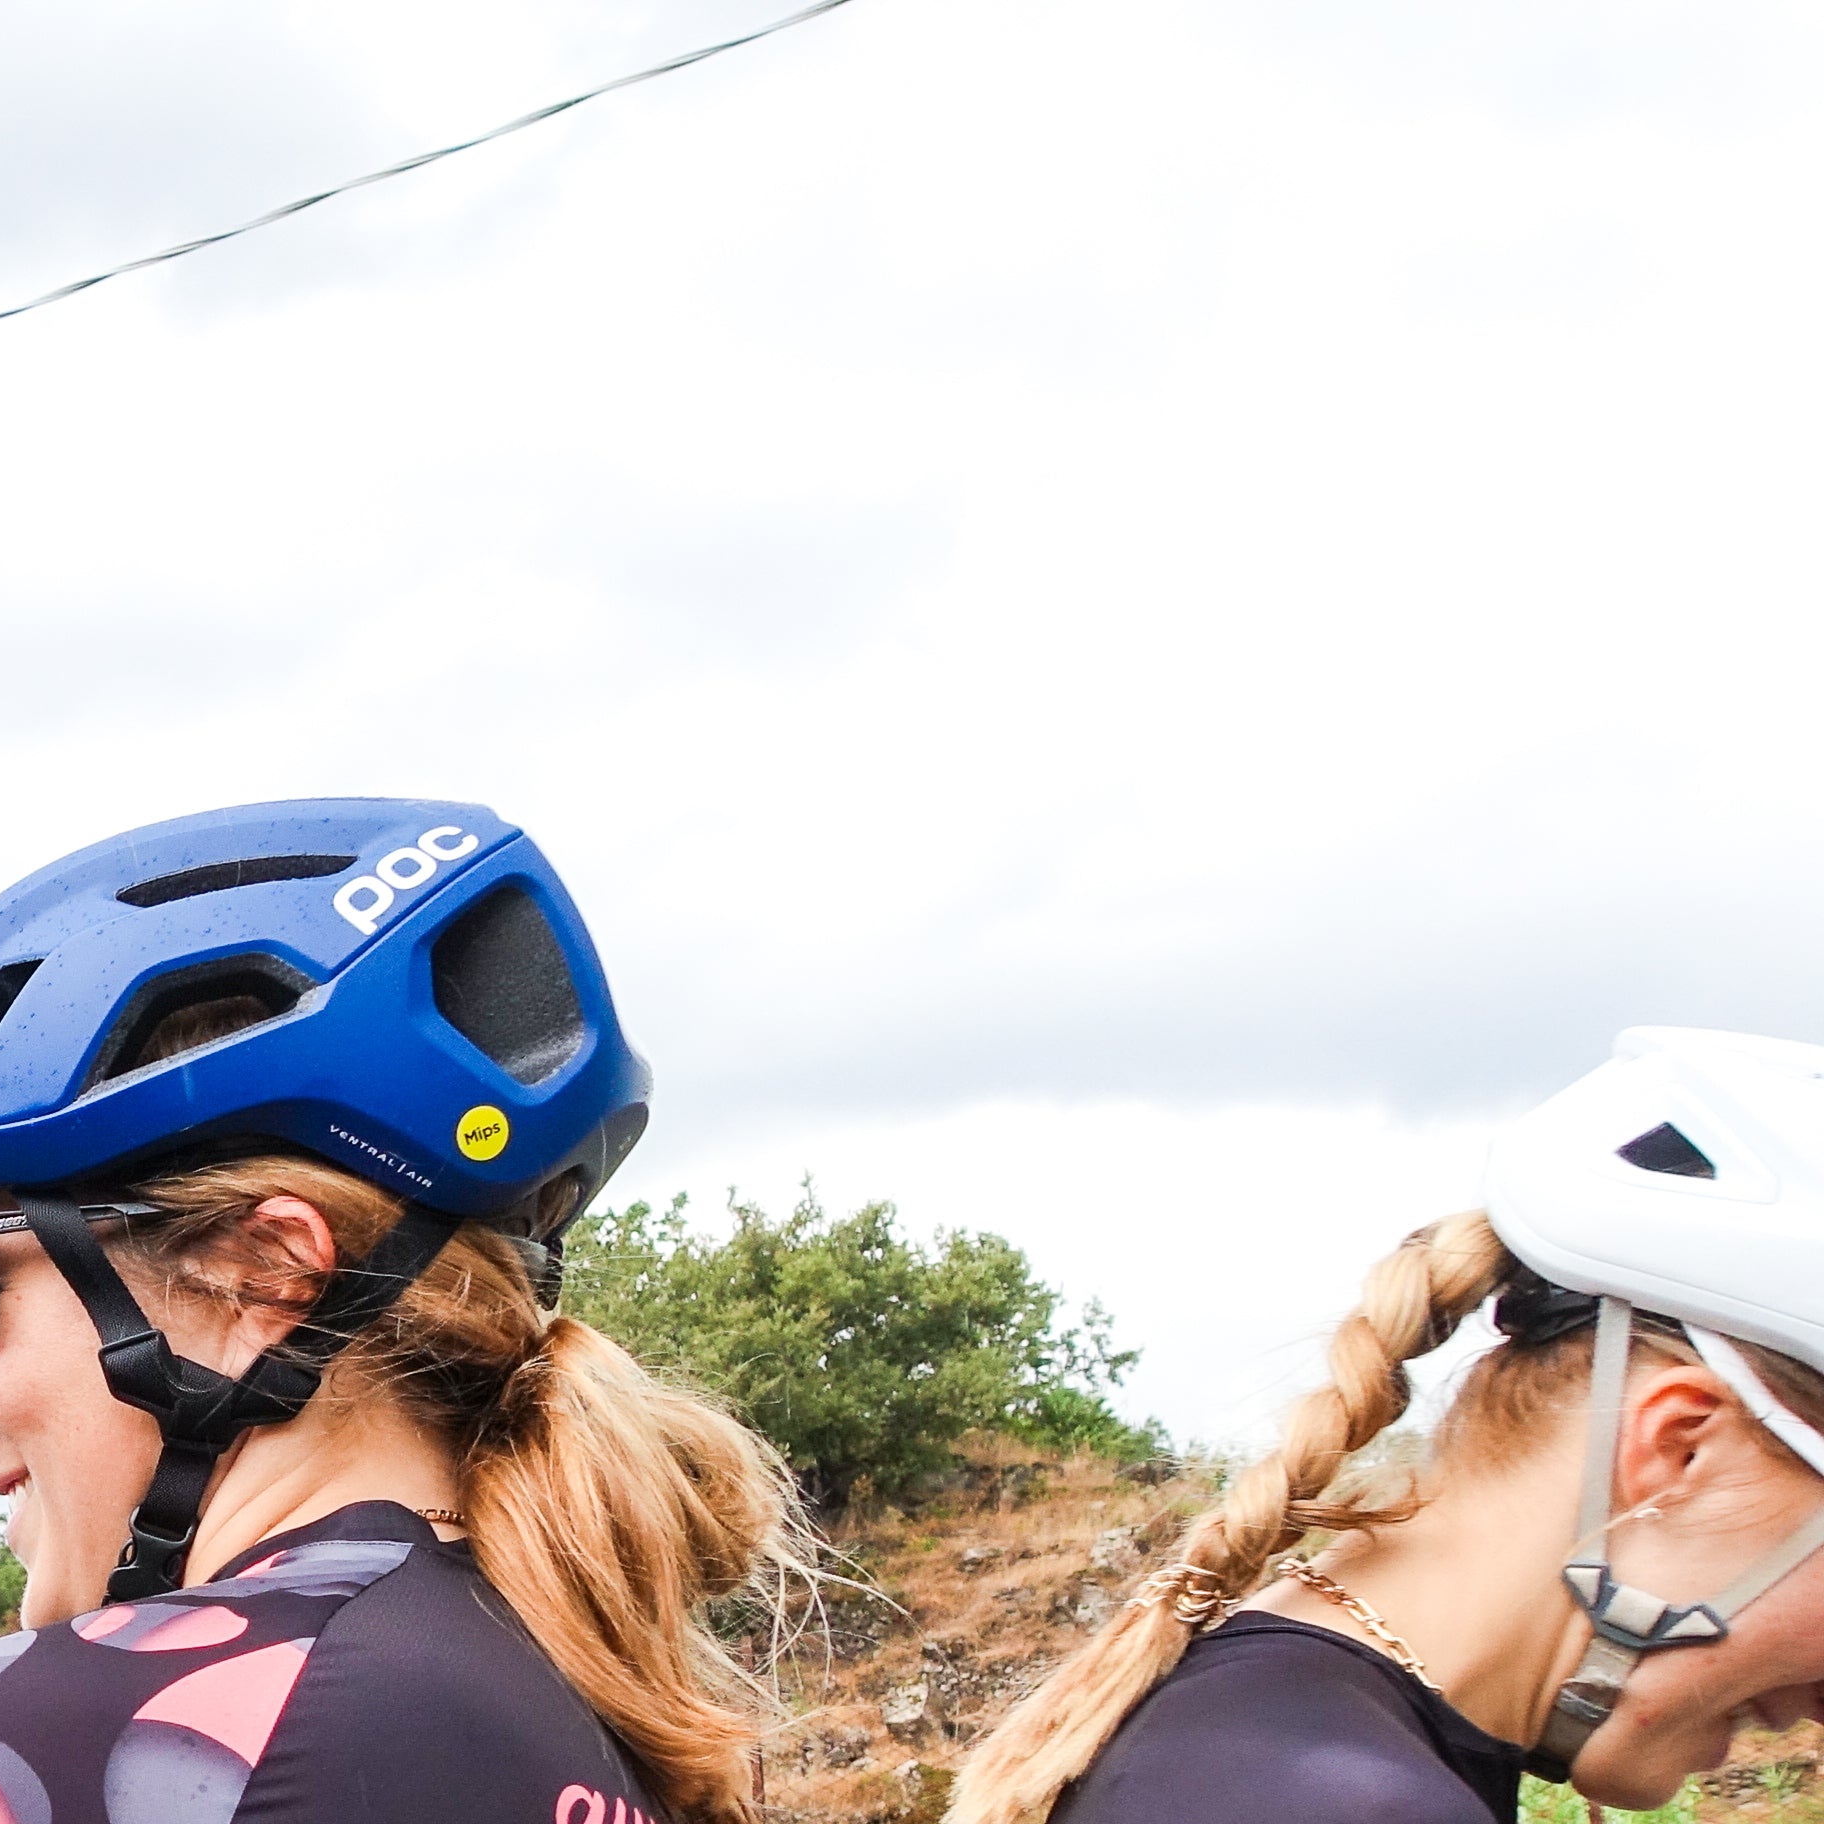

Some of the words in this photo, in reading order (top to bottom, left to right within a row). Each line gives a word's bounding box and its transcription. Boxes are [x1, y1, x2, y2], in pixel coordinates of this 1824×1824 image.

[463, 1121, 502, 1146] Mips
[329, 1124, 395, 1167] VENTRAL
[406, 1171, 433, 1188] AIR
